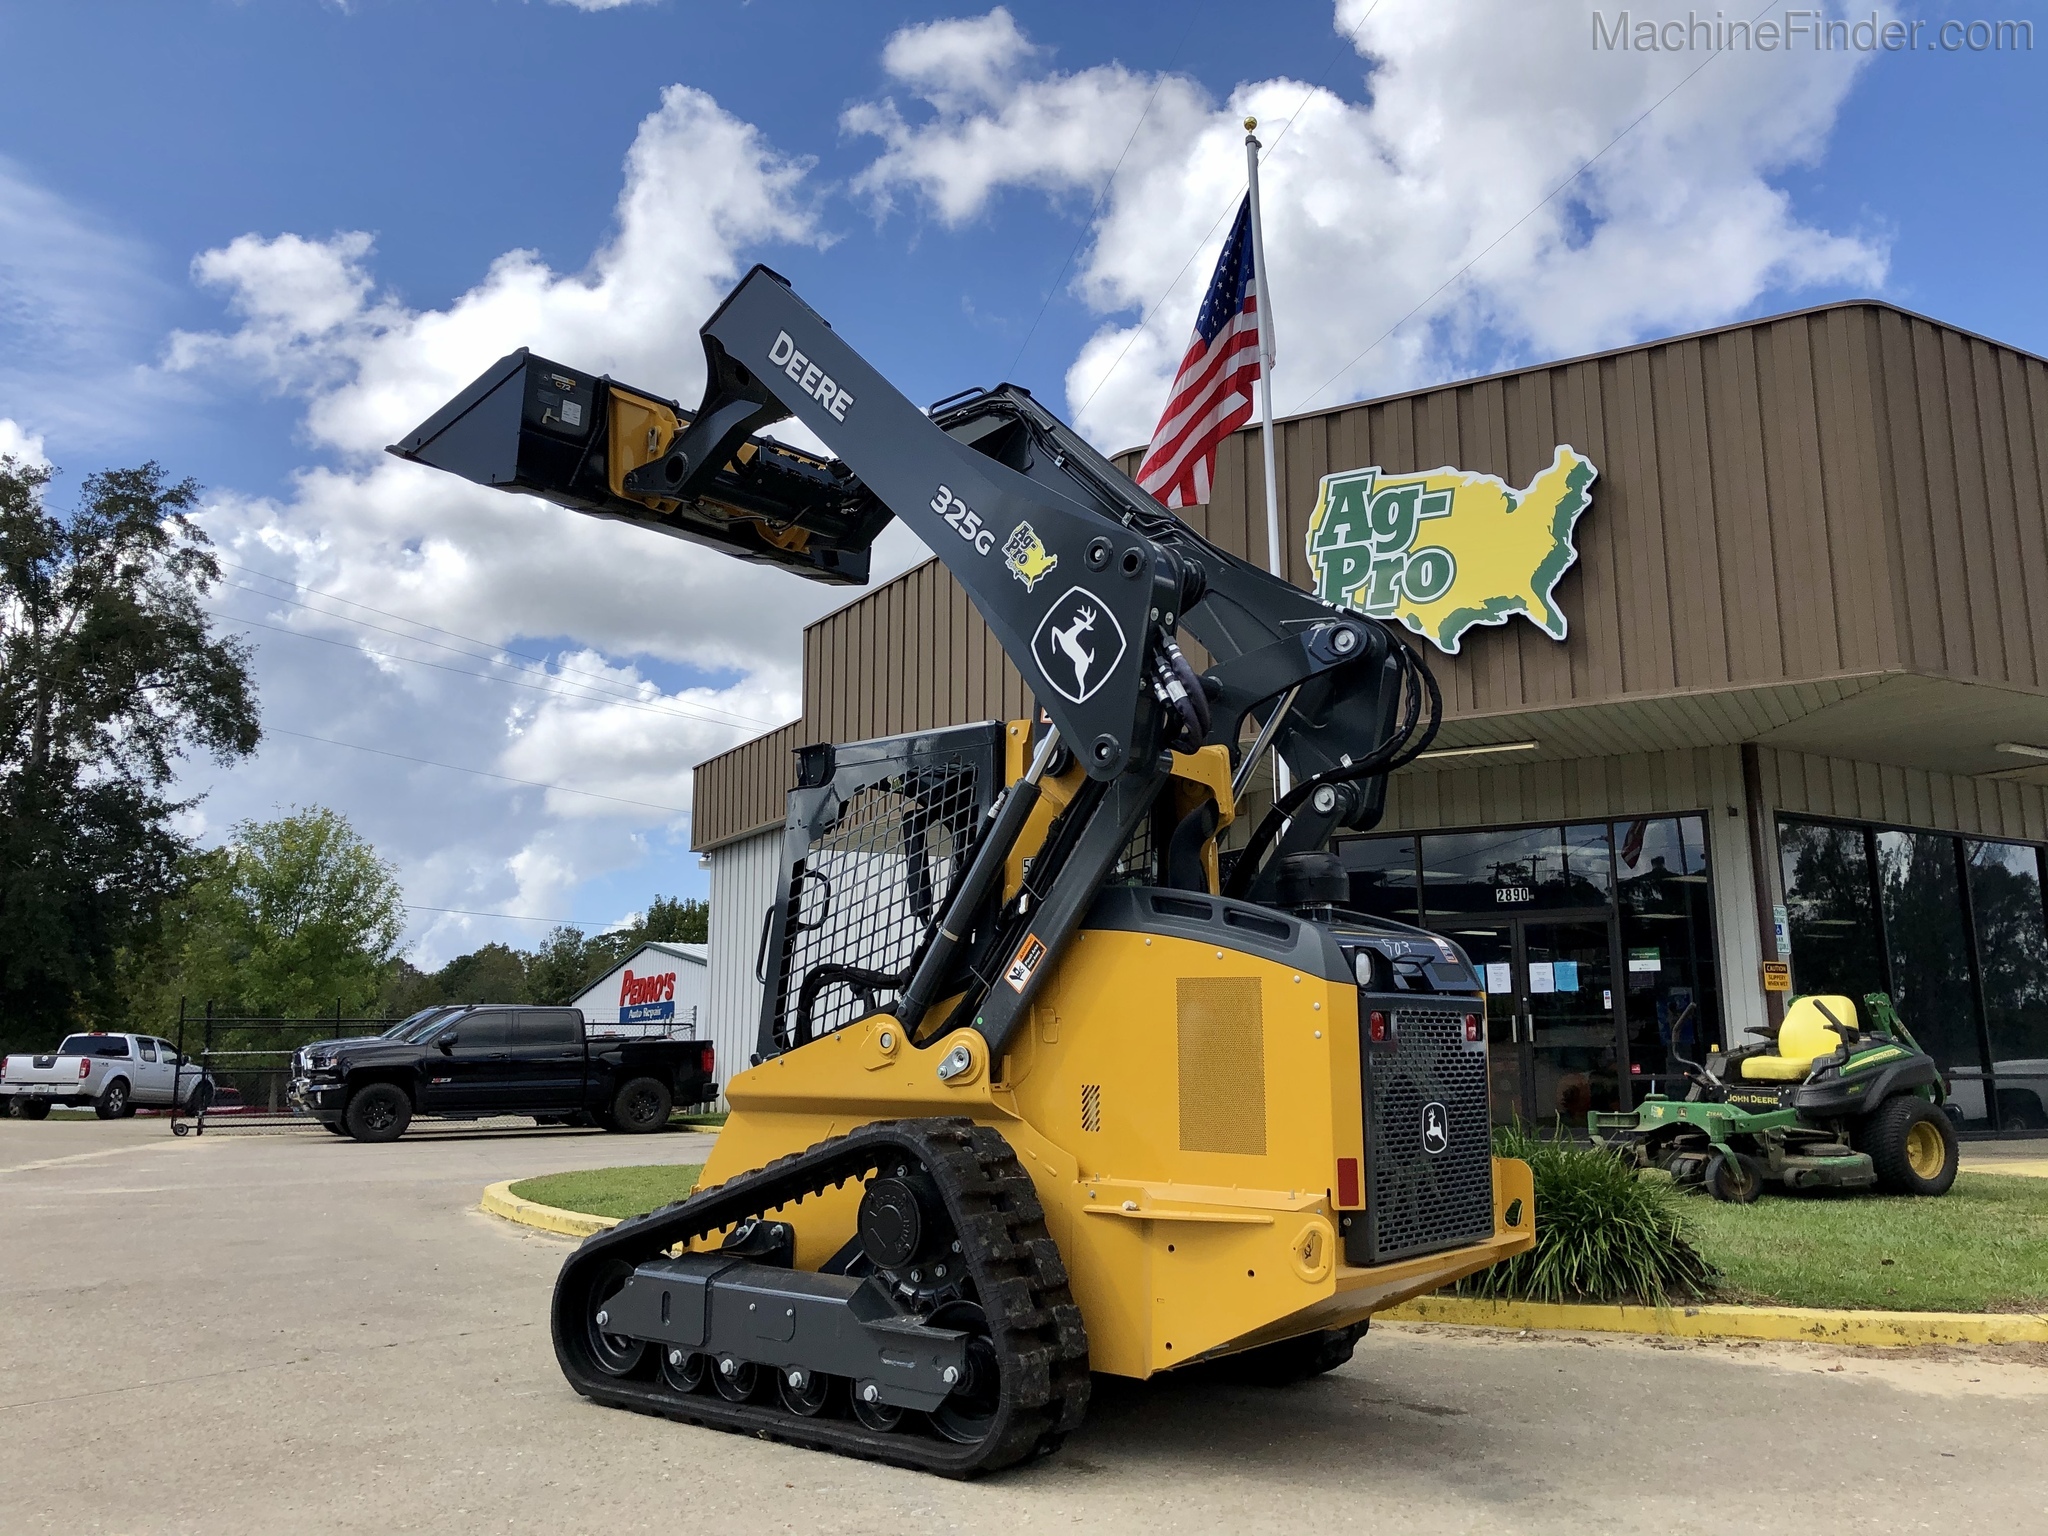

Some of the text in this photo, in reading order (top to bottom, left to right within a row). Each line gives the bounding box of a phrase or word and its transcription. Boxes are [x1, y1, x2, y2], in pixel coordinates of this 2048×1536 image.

[768, 330, 854, 423] DEERE
[930, 485, 996, 556] 325G
[1313, 472, 1452, 554] Ag-
[1005, 538, 1029, 565] Pro
[1320, 545, 1454, 611] Pro
[1497, 888, 1528, 902] 2890
[619, 970, 676, 1007] PEDRO'S
[1727, 1094, 1779, 1105] JOHN DEERE
